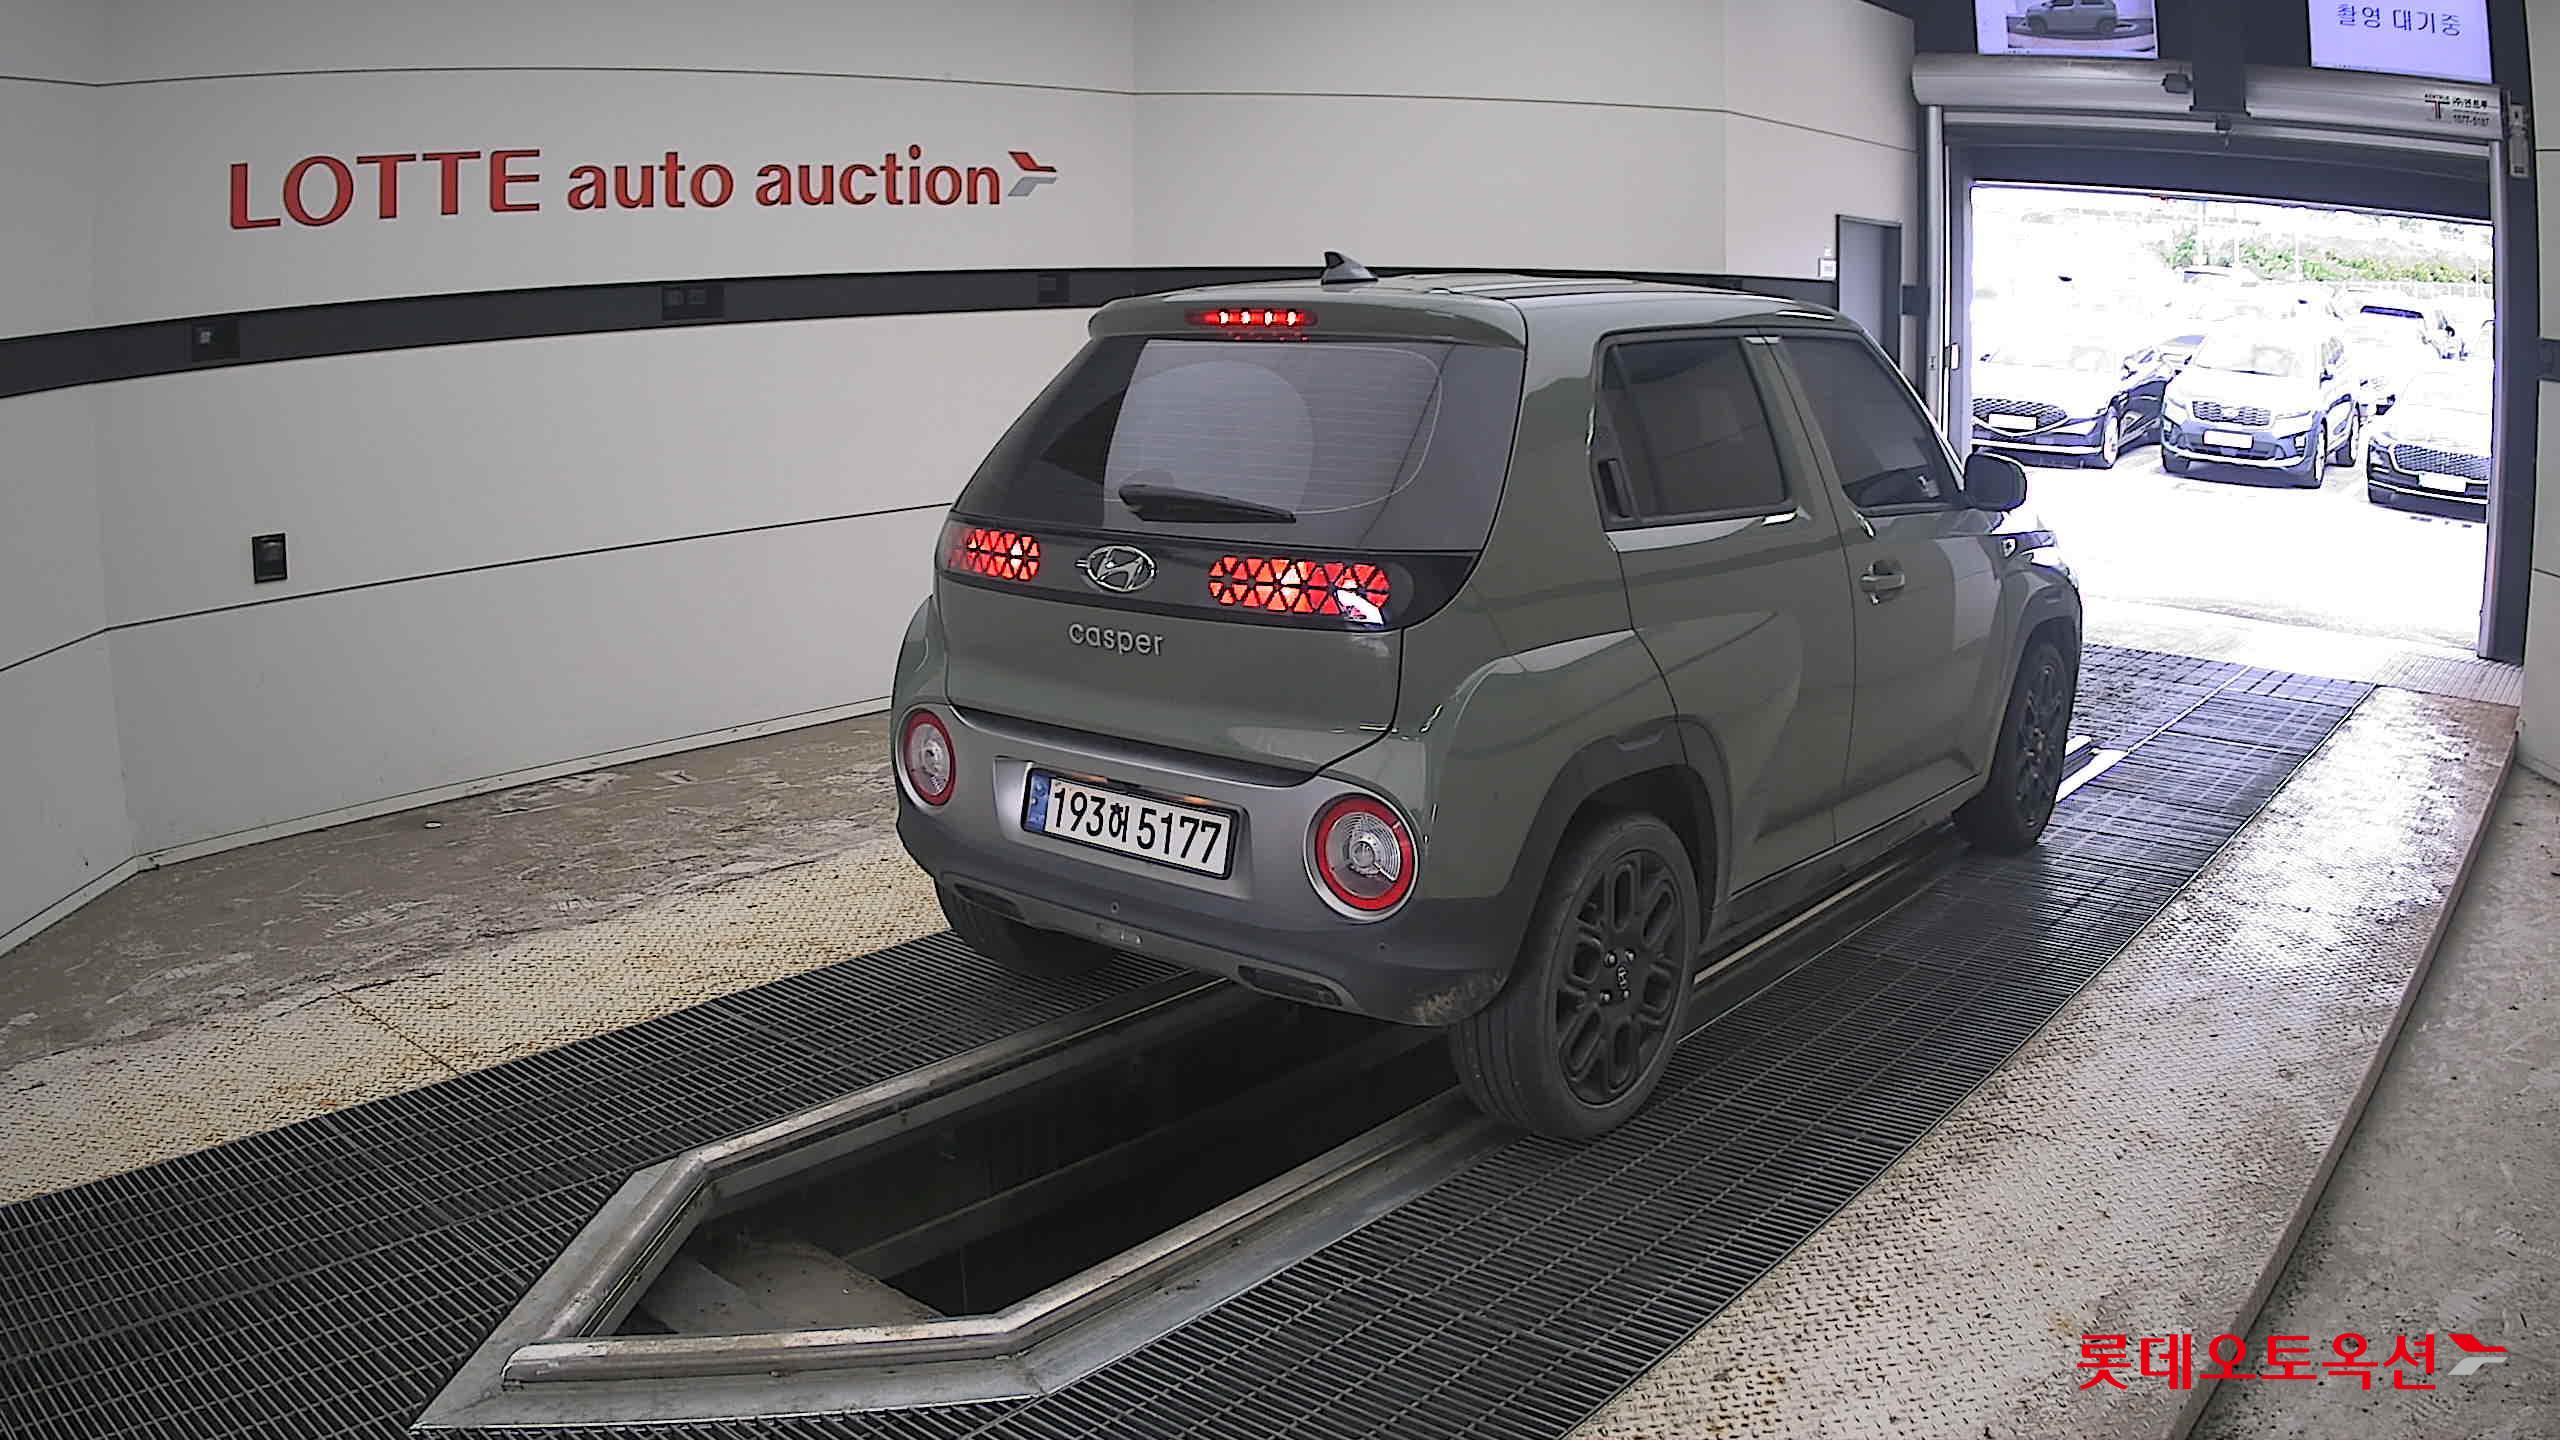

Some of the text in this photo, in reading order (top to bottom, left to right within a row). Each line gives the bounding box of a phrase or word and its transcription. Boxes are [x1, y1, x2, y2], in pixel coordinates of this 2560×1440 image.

[2338, 4, 2461, 37] 촬영 대기중
[230, 144, 1000, 230] LOTTE auto auction
[1068, 622, 1164, 656] casper
[1053, 787, 1223, 865] 193허 5177
